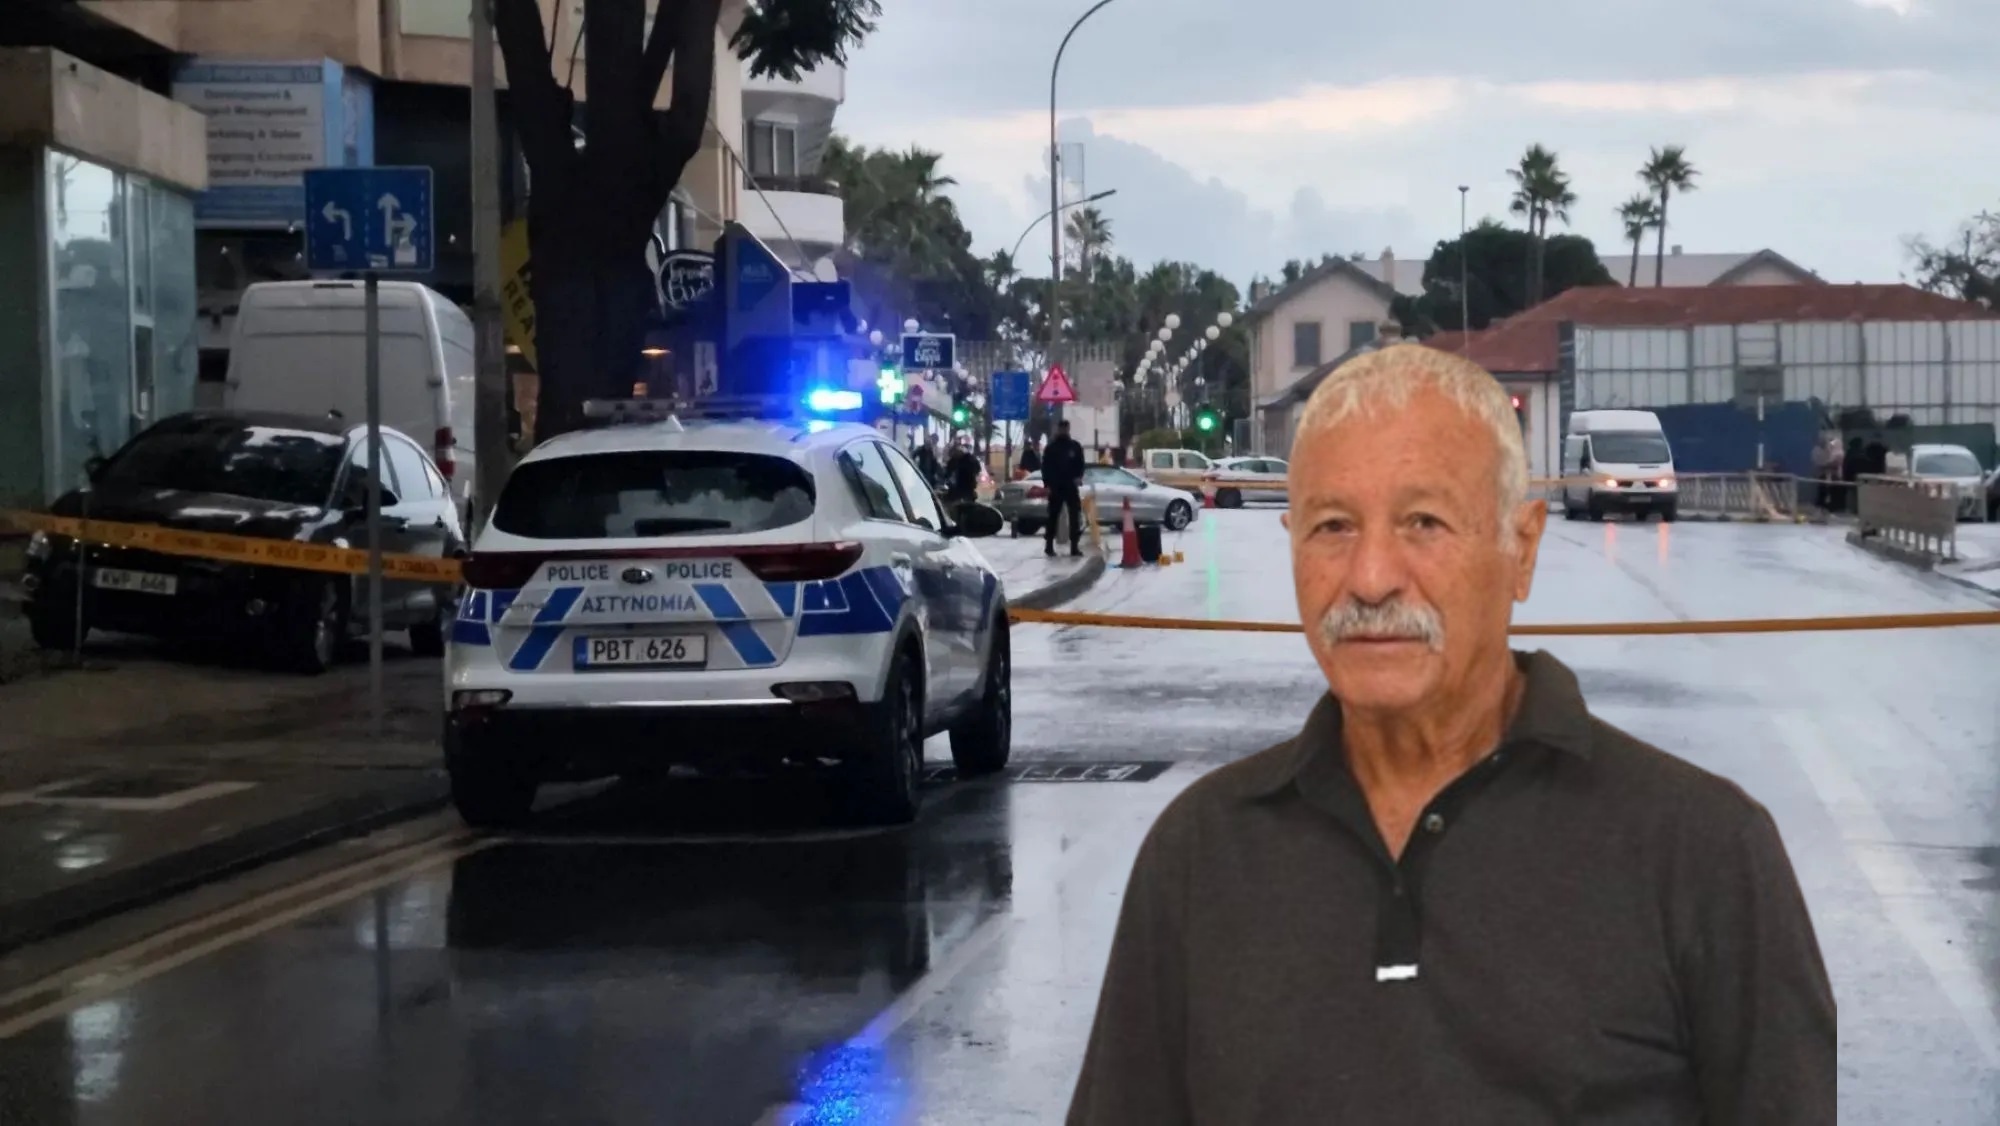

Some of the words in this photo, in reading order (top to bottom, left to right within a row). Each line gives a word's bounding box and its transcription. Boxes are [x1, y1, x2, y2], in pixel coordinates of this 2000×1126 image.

[203, 88, 281, 102] Development
[283, 89, 293, 101] &
[234, 105, 307, 120] Management
[206, 128, 255, 142] arketing
[267, 544, 299, 560] POLICE
[547, 564, 609, 581] POLICE
[666, 562, 732, 579] POLICE
[581, 595, 697, 614] ΑΣΤΥΝΟΜΙΑ
[593, 639, 634, 661] PBT
[647, 638, 686, 660] 626
